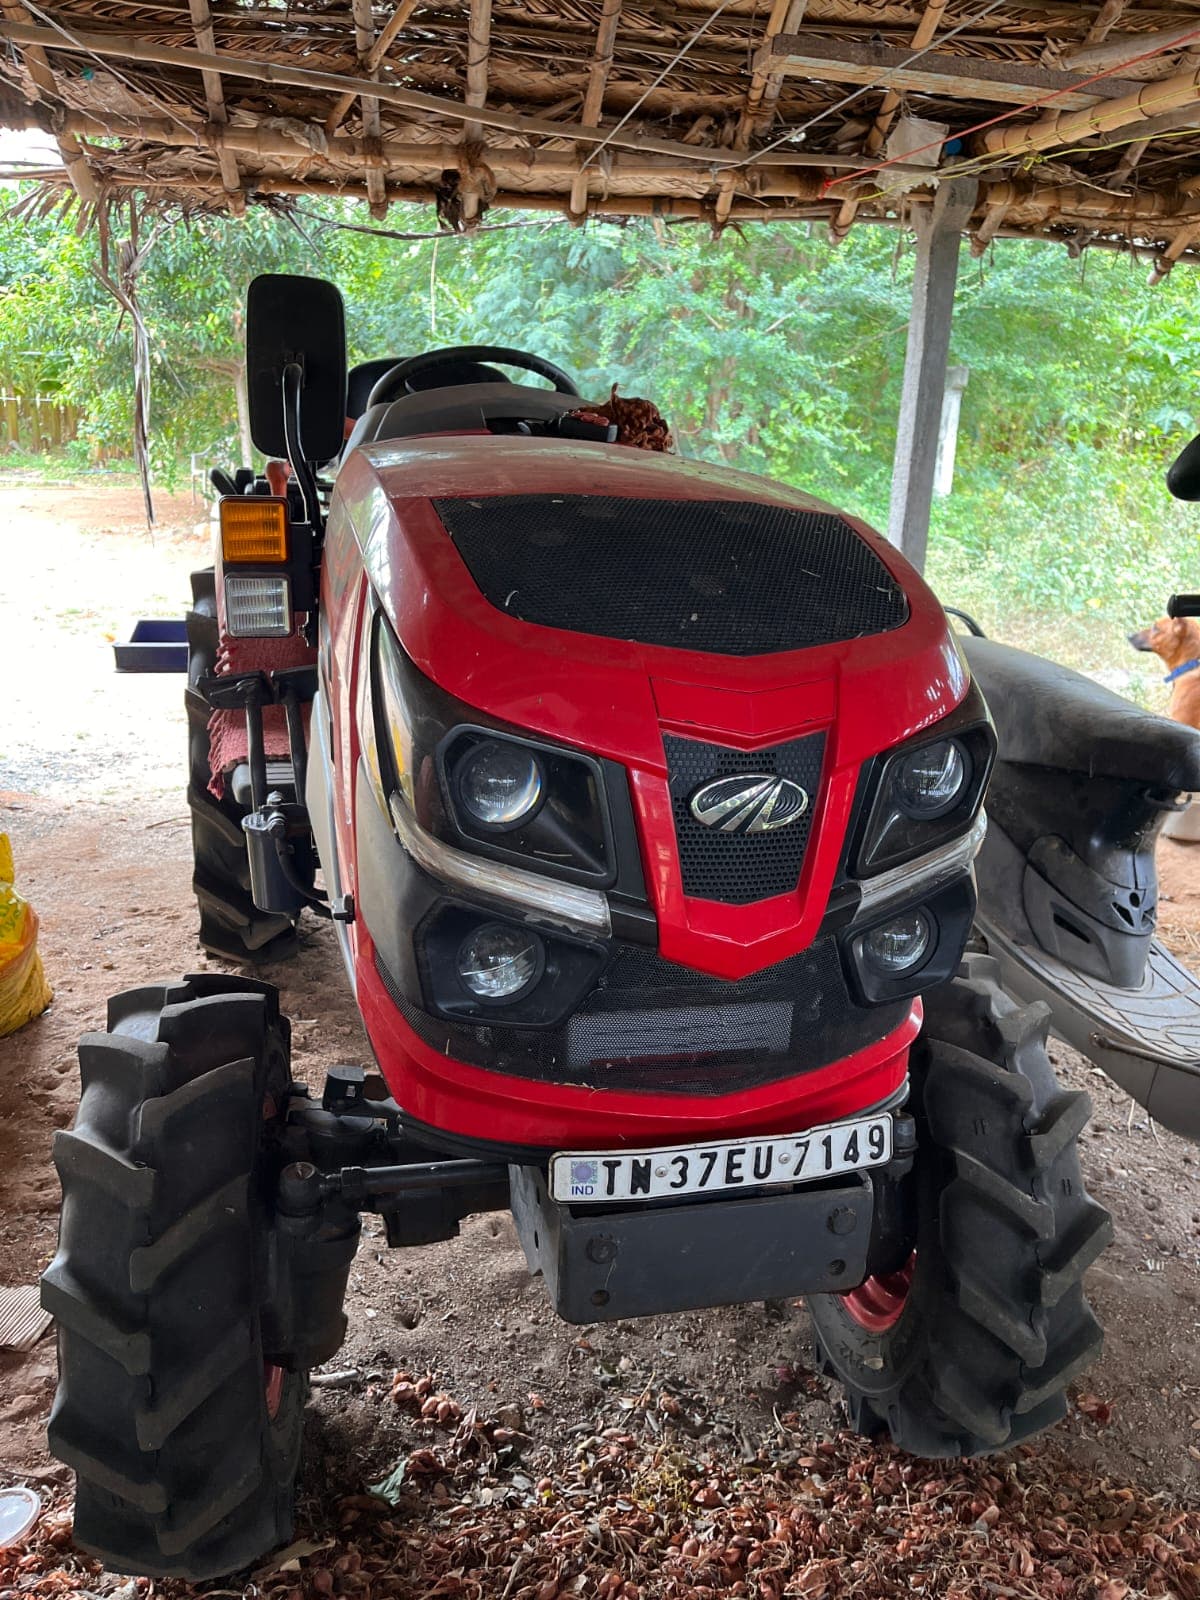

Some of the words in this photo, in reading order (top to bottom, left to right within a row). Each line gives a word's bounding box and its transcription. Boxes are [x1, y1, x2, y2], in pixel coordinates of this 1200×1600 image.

[602, 1158, 652, 1196] TN
[669, 1144, 774, 1189] 37EU
[792, 1124, 886, 1177] 7149
[571, 1185, 595, 1196] IND
